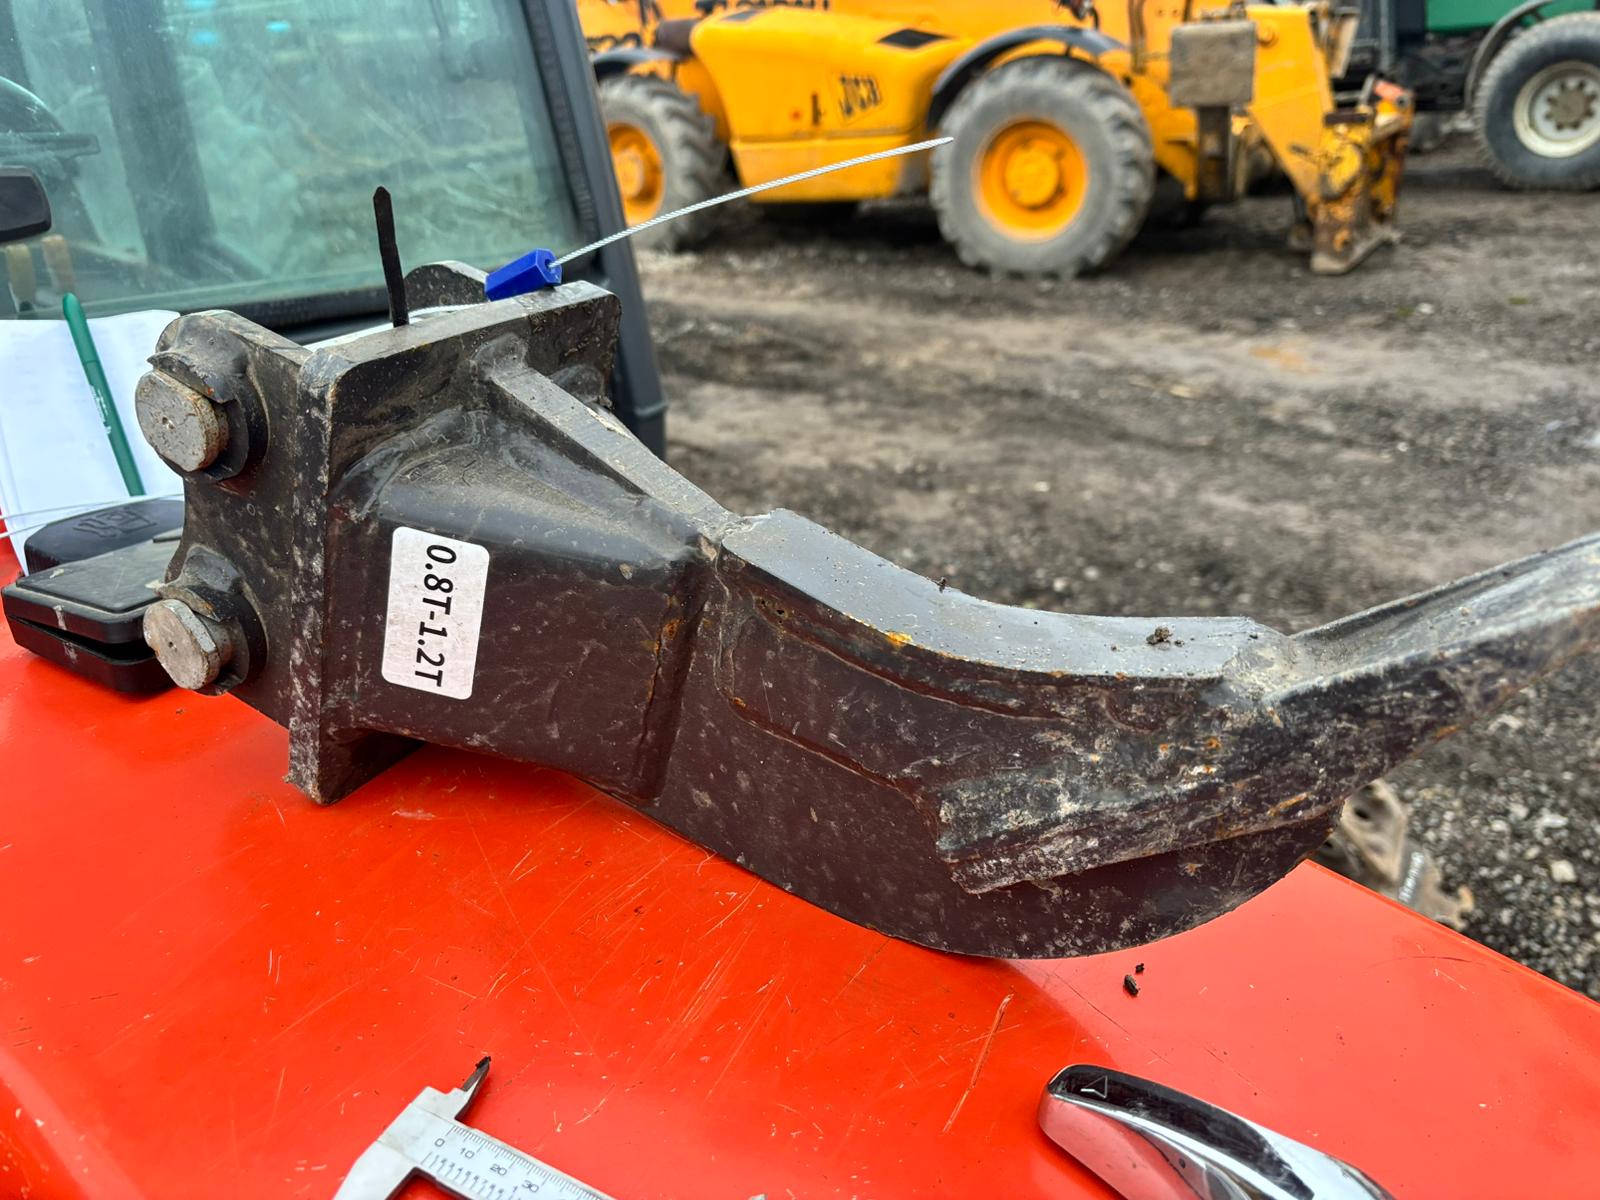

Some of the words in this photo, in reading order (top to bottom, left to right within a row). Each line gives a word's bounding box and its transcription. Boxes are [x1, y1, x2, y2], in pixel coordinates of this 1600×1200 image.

[415, 544, 457, 687] 0.8T-1.2T
[434, 1138, 445, 1147] 0
[460, 1148, 475, 1159] 10
[490, 1164, 507, 1176] 20
[522, 1180, 539, 1193] 30
